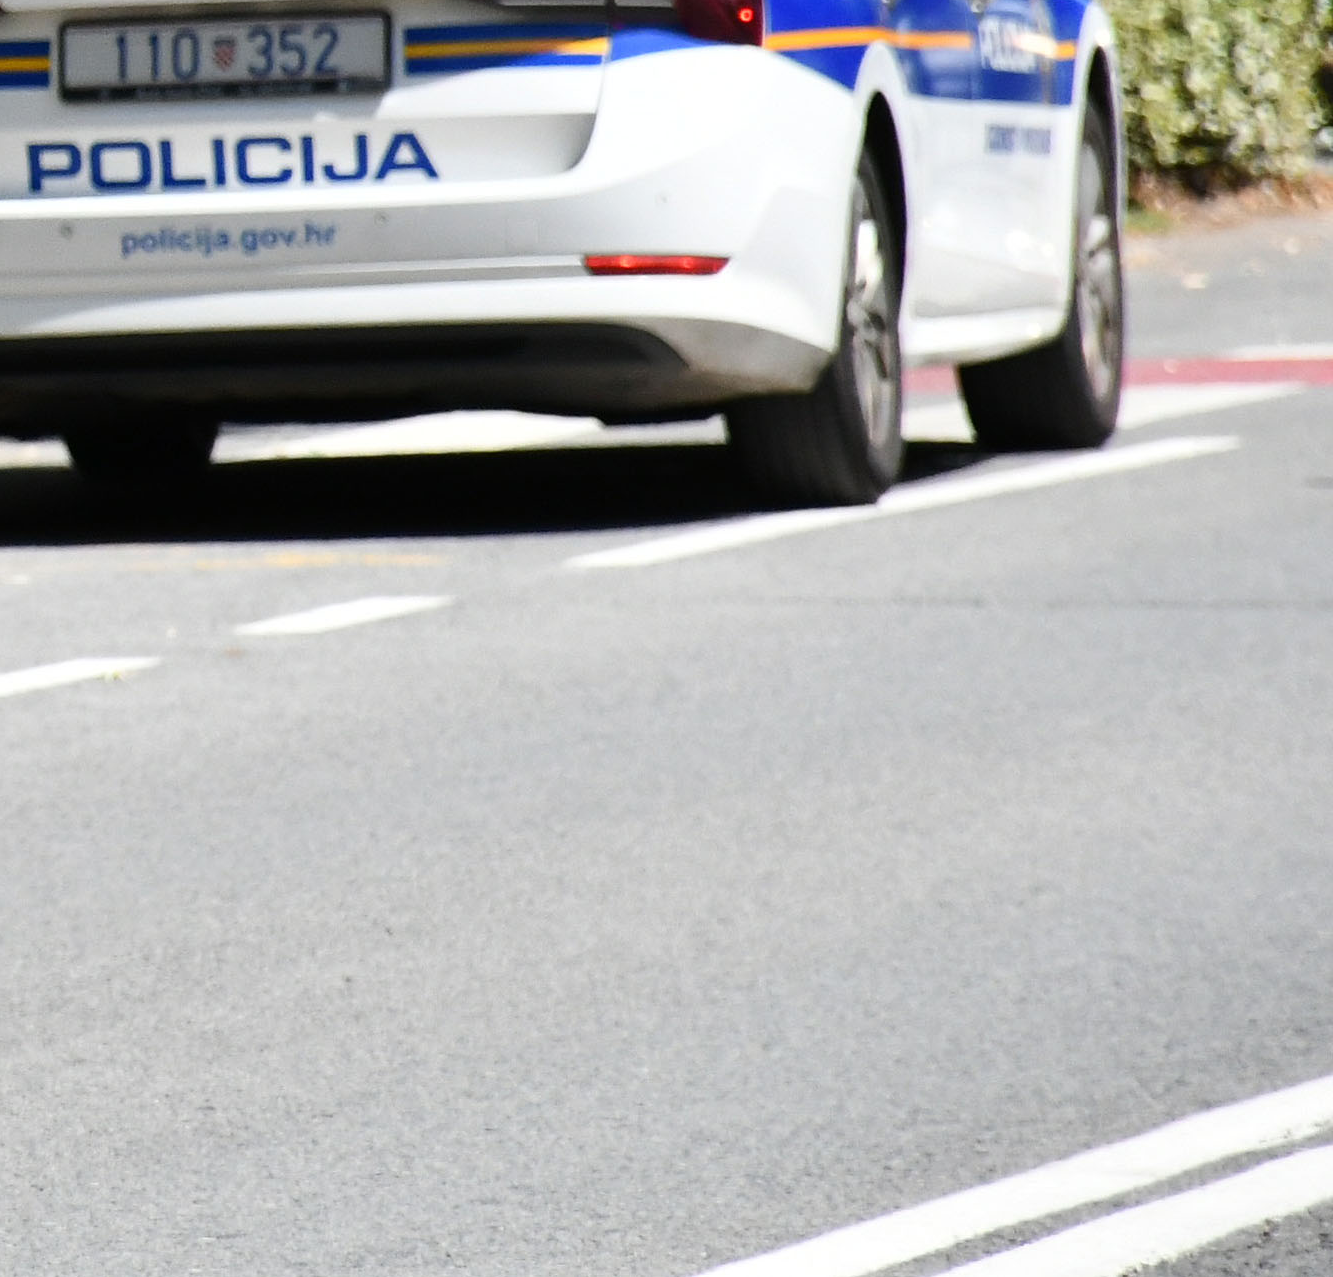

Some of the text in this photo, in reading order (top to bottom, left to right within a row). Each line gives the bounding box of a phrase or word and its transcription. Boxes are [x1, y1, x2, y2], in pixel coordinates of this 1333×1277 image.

[115, 22, 340, 82] 110 352
[26, 131, 440, 193] POLICIJA
[120, 220, 338, 258] policija.gov.hr
